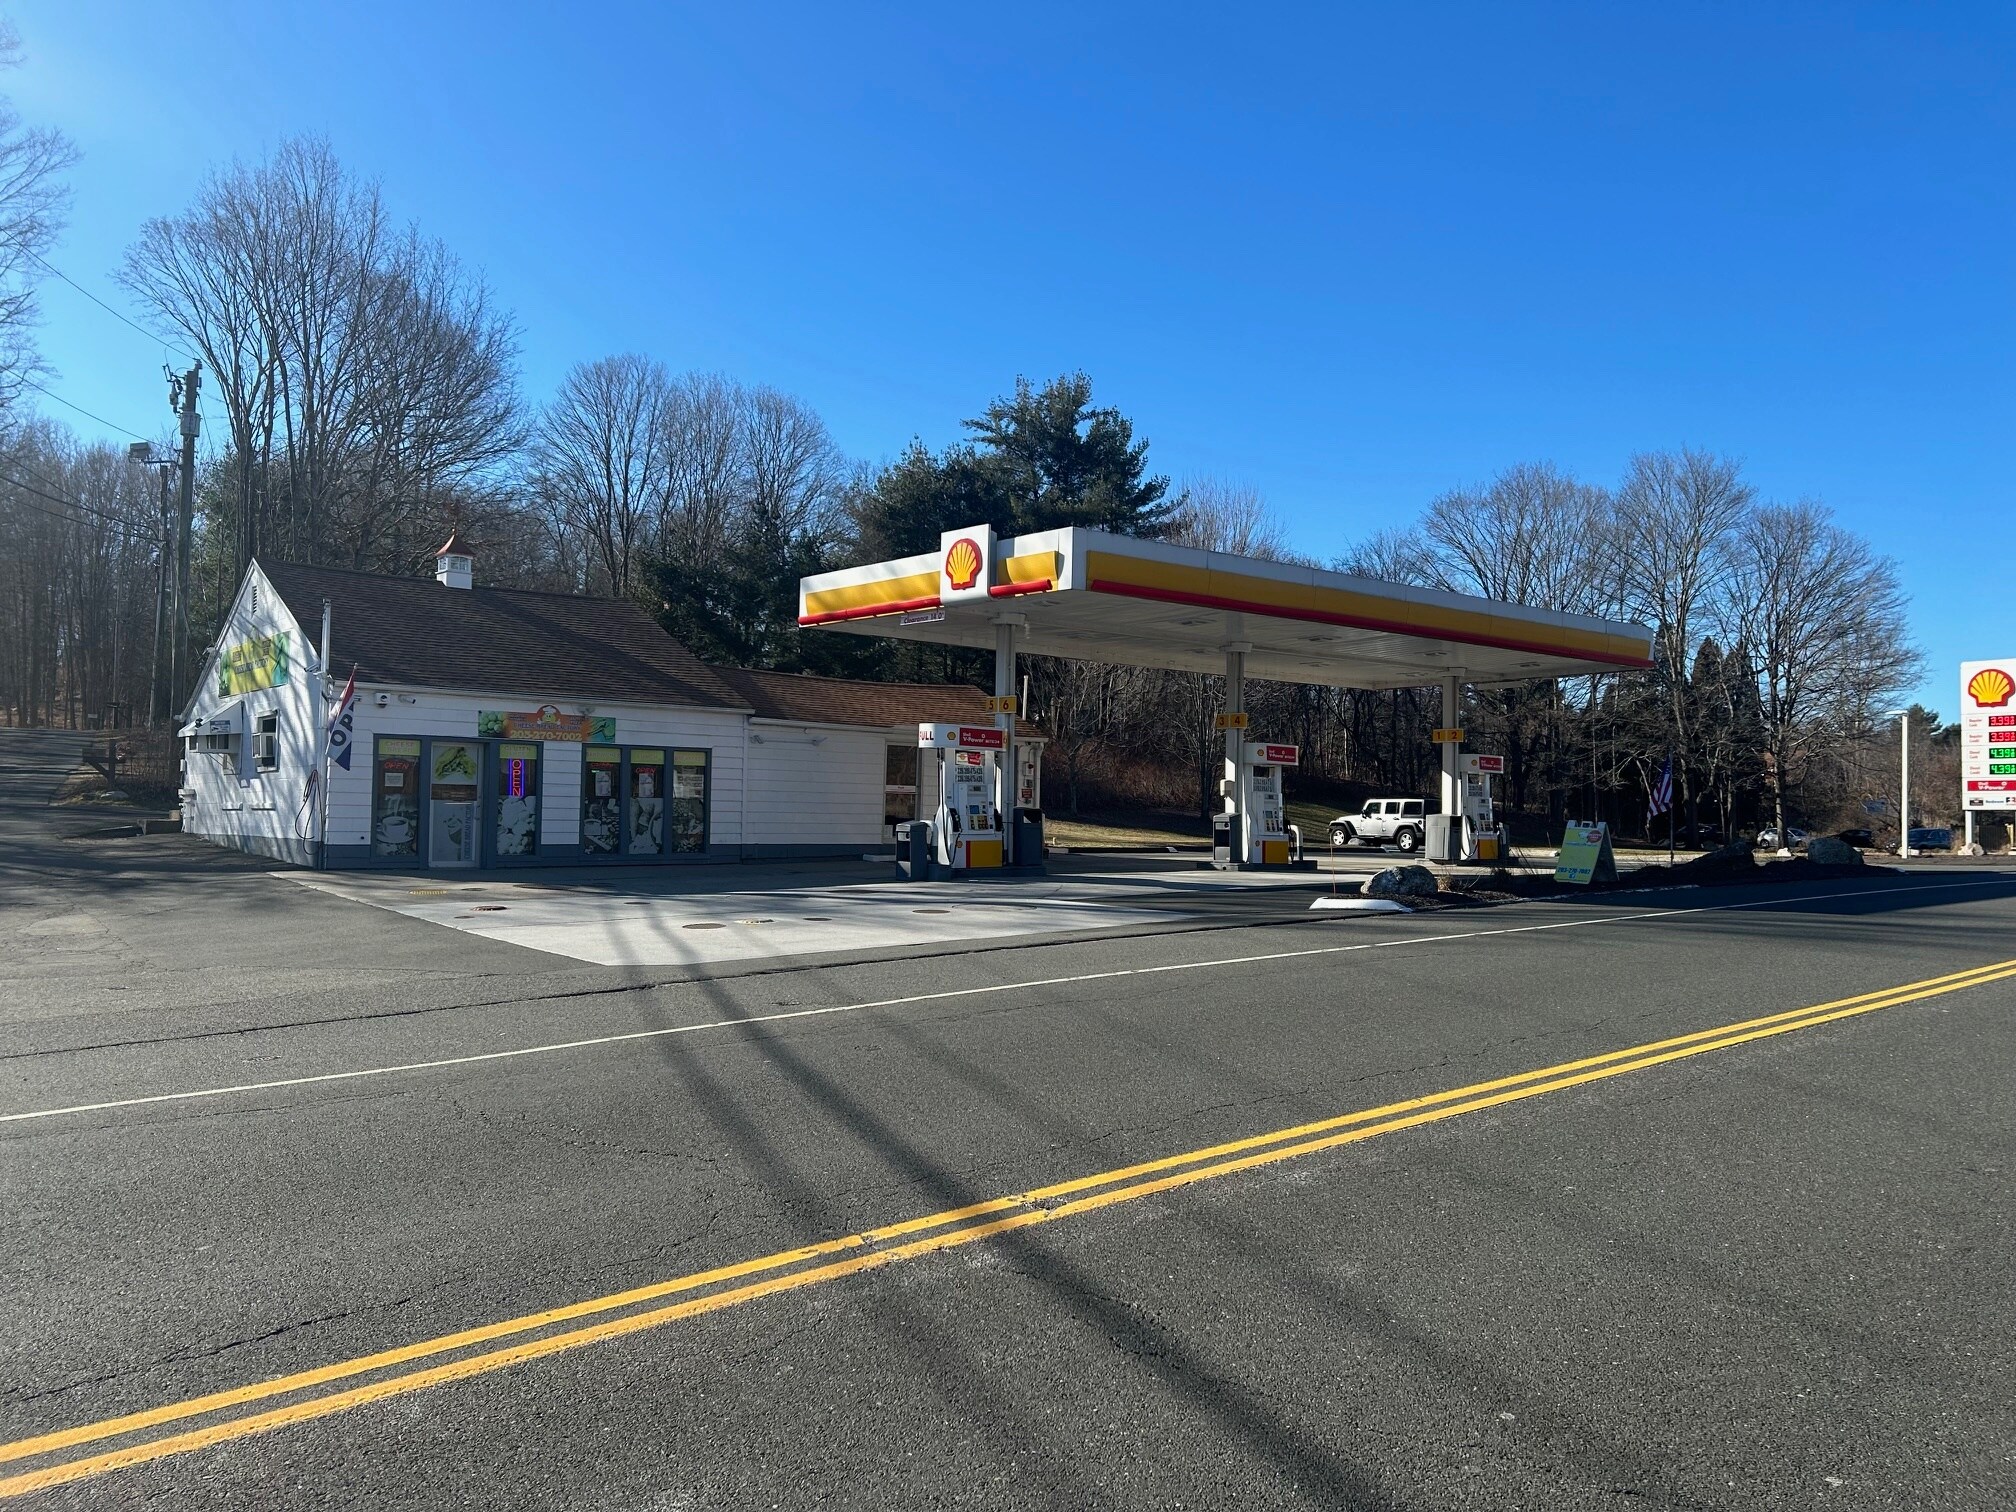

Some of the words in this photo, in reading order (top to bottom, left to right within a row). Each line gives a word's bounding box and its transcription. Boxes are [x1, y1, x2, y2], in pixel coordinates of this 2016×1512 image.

[904, 615, 928, 623] Clearance
[988, 700, 994, 710] 5
[1003, 699, 1009, 710] 6
[1219, 717, 1225, 726] 3
[1234, 716, 1241, 726] 4
[510, 729, 582, 741] 203-270-7002
[1452, 731, 1458, 740] 2
[384, 760, 410, 770] OPEN
[512, 759, 522, 797] OPEN
